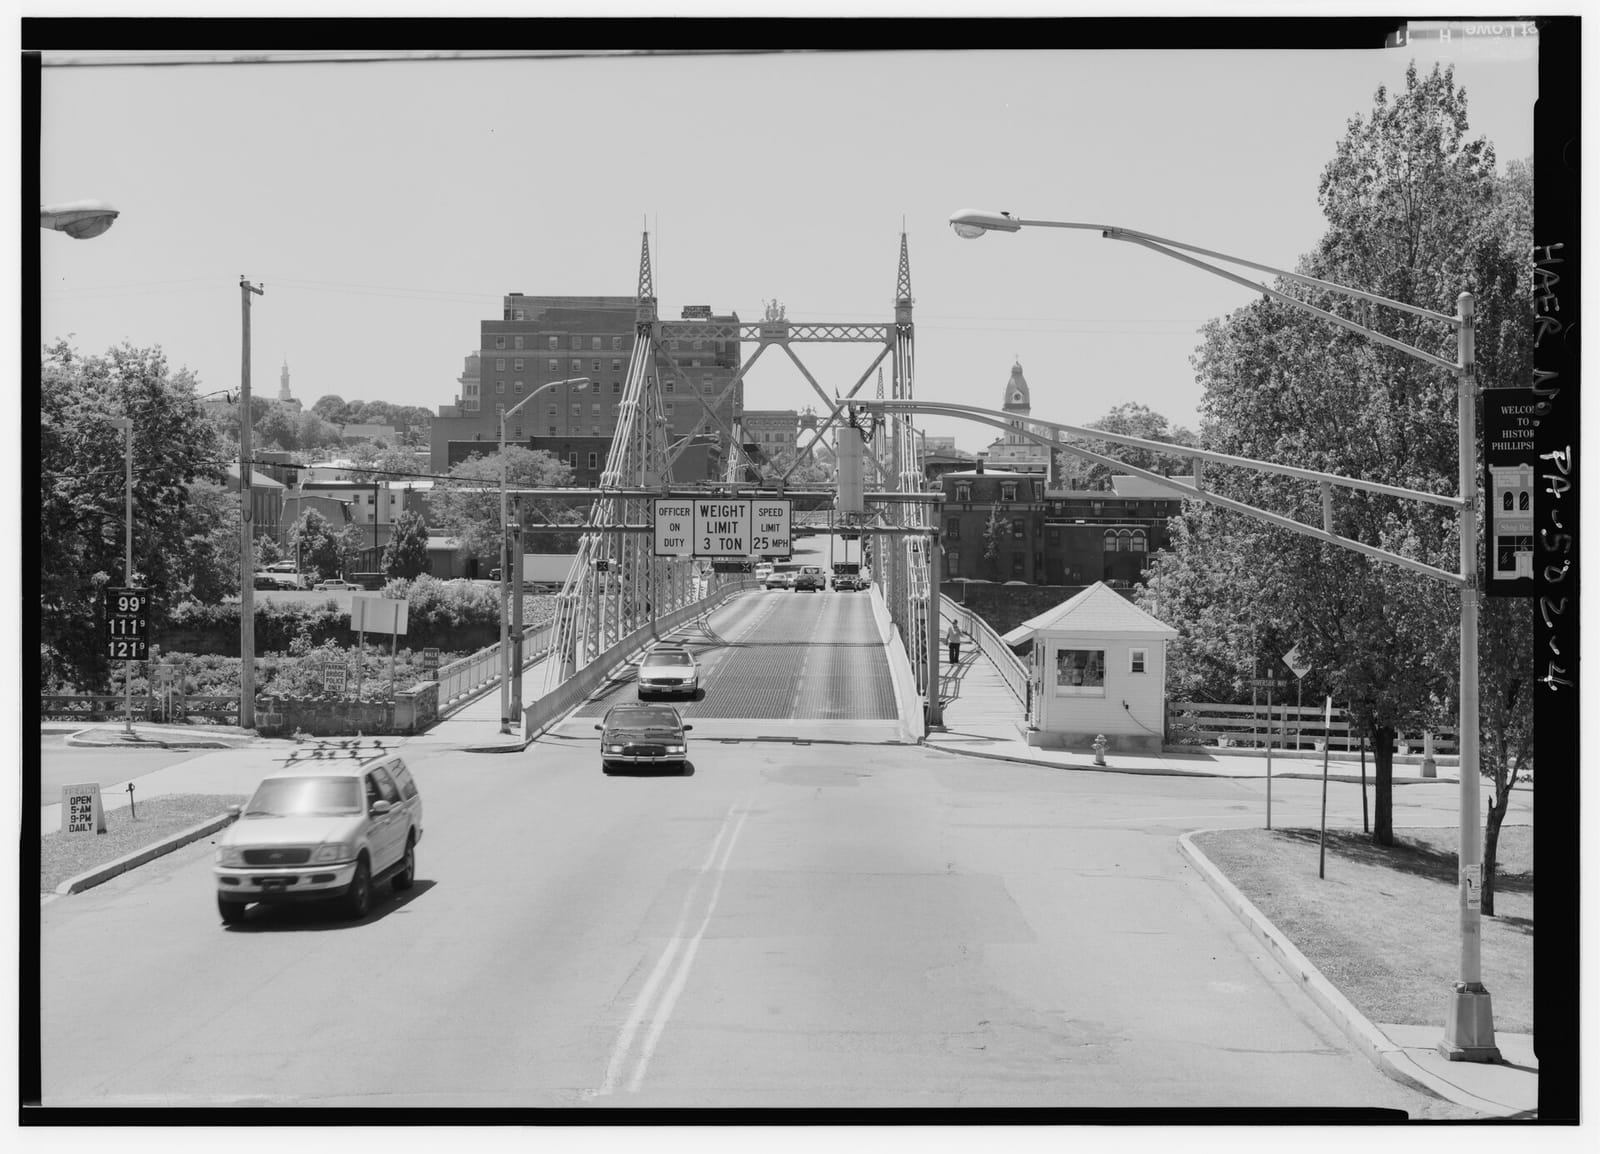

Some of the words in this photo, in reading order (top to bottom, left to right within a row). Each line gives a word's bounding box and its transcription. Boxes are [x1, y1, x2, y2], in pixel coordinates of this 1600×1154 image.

[1464, 23, 1515, 37] Lowe
[1533, 242, 1564, 349] HAER
[1500, 405, 1535, 415] WELCO
[1517, 417, 1530, 426] TO
[658, 507, 691, 517] OFFICER
[700, 504, 746, 518] WEIGHT
[758, 507, 784, 517] SPEED
[669, 523, 681, 532] ON
[706, 521, 739, 534] LIMIT
[760, 523, 781, 533] LIMIT
[663, 538, 685, 547] DUTY
[703, 537, 711, 550] 3
[719, 537, 742, 550] TON
[753, 537, 769, 550] 25
[771, 538, 789, 548] MPH
[70, 795, 92, 806] OPEN
[69, 822, 93, 833] DAILY
